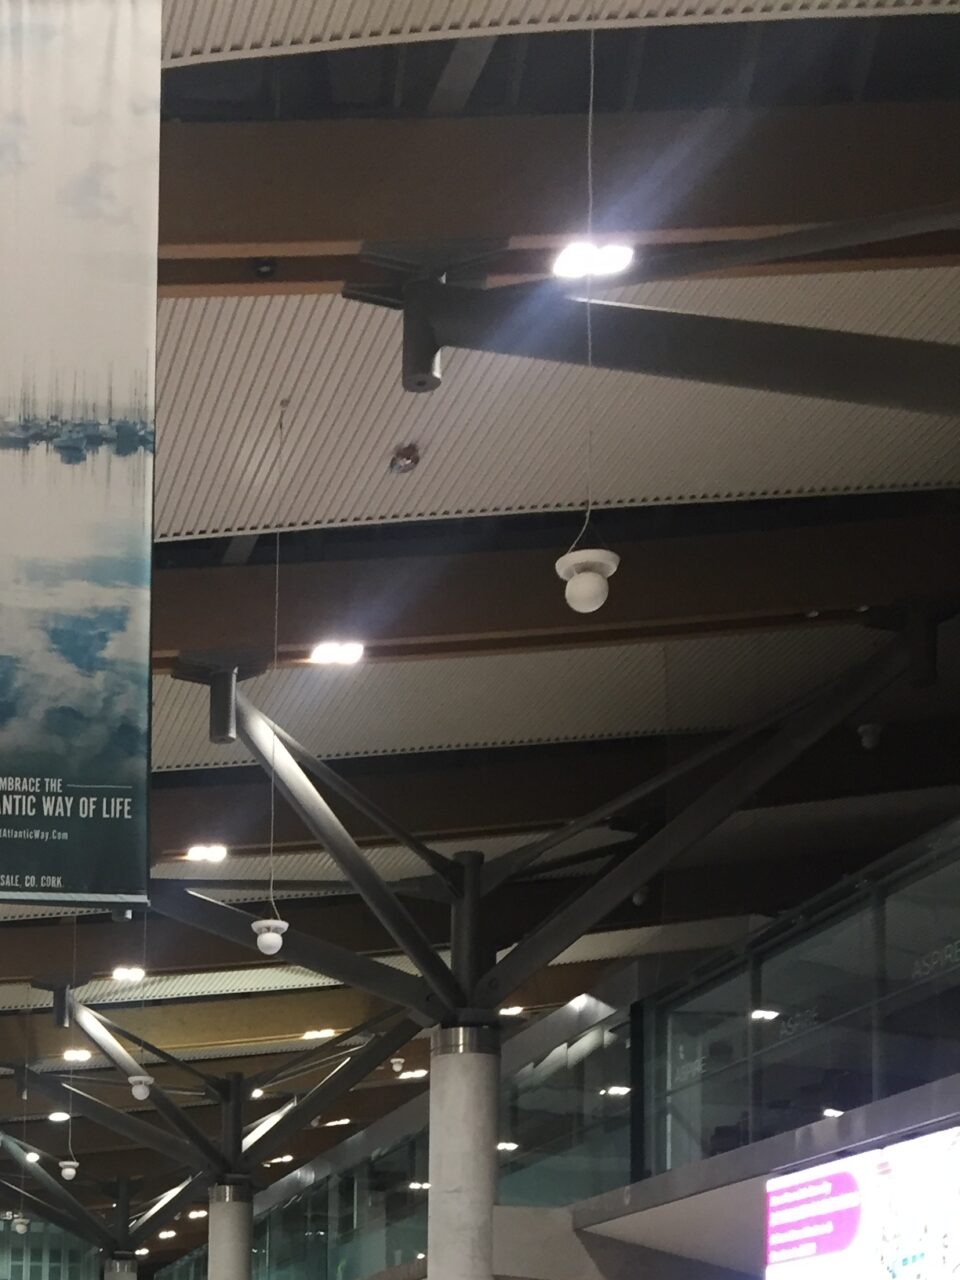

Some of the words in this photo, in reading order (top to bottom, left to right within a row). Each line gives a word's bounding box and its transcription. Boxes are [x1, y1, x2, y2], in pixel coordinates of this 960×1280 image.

[44, 777, 63, 793] THE
[42, 795, 74, 817] WAY
[79, 797, 97, 818] OF
[102, 797, 132, 819] LIFE
